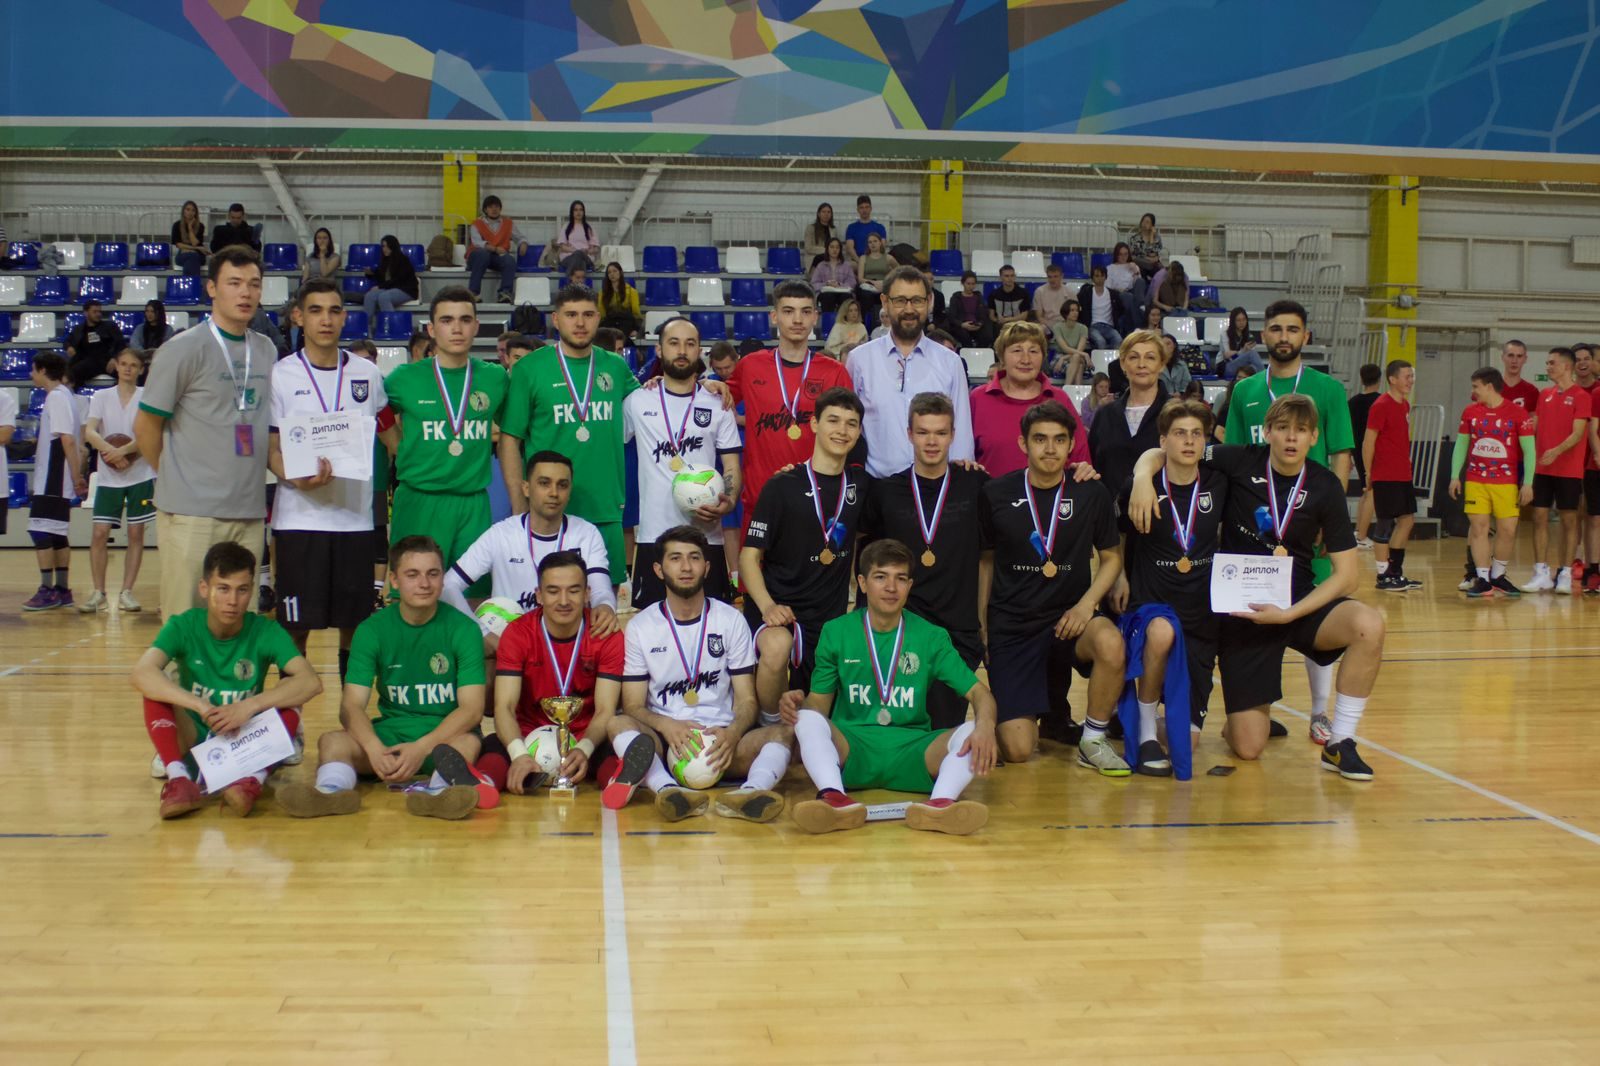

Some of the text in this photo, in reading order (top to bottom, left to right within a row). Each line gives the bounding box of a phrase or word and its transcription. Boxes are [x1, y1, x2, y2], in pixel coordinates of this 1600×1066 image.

[552, 403, 576, 425] FK
[311, 423, 350, 436] ДИПЛОМ
[422, 420, 488, 441] FK KM
[1243, 566, 1280, 575] ДИПЛОМ
[283, 596, 299, 622] 11
[387, 683, 456, 705] FK TKM
[849, 683, 914, 708] FK KM
[230, 726, 270, 751] ДИПЛОМ
